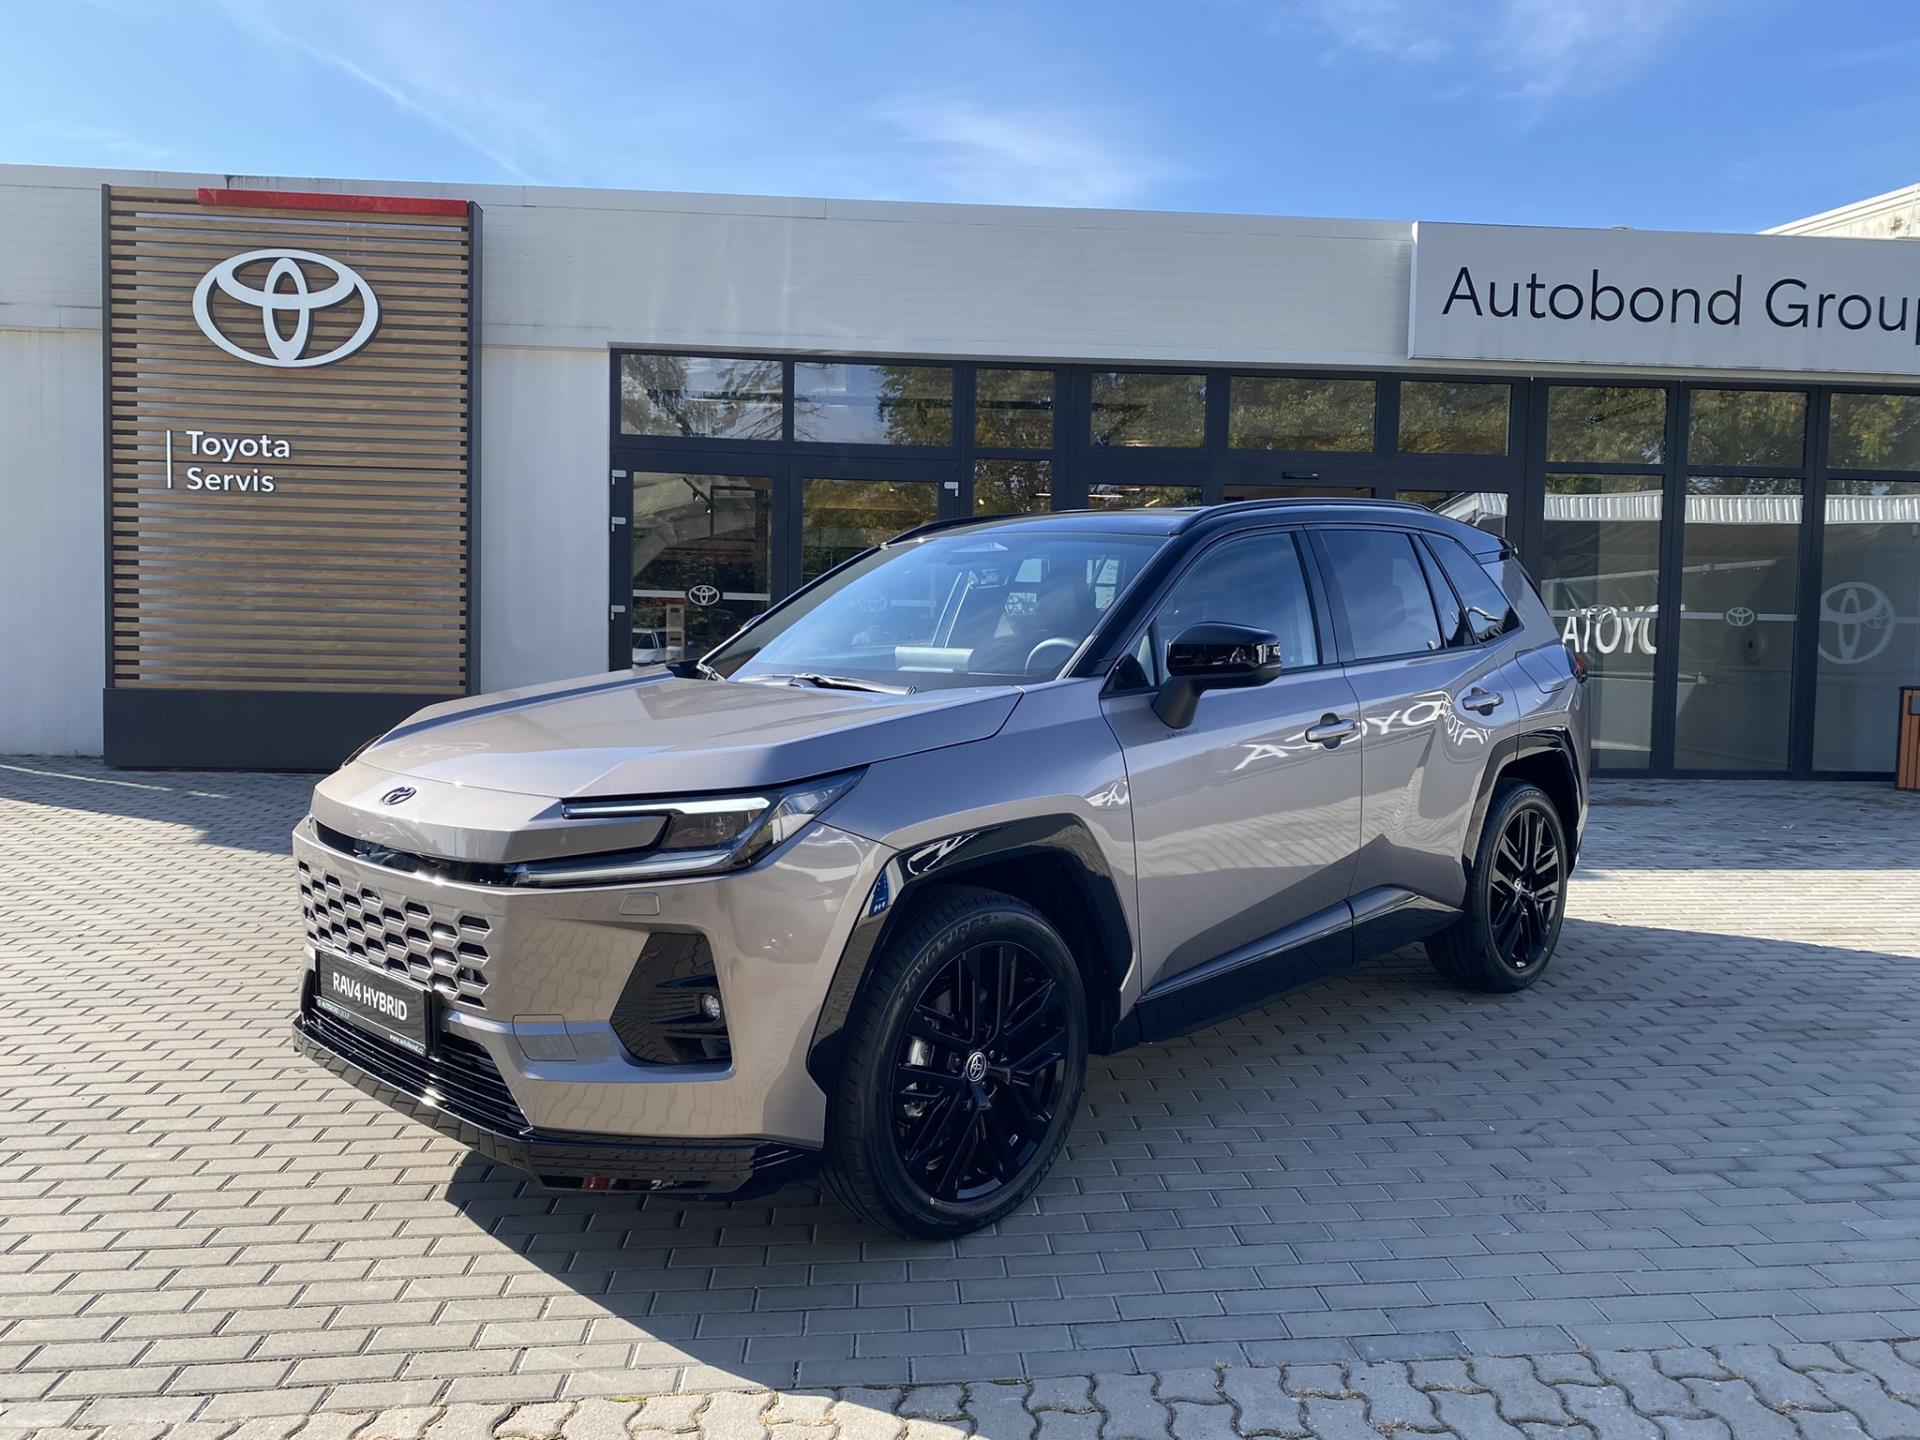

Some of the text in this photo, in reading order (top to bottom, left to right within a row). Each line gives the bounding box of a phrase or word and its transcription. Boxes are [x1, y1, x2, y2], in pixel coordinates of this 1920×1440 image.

[1442, 266, 1920, 346] Autobond Grou
[186, 430, 291, 463] Toyota
[186, 467, 276, 493] Servis
[332, 971, 408, 1021] RAV4 HYBRID
